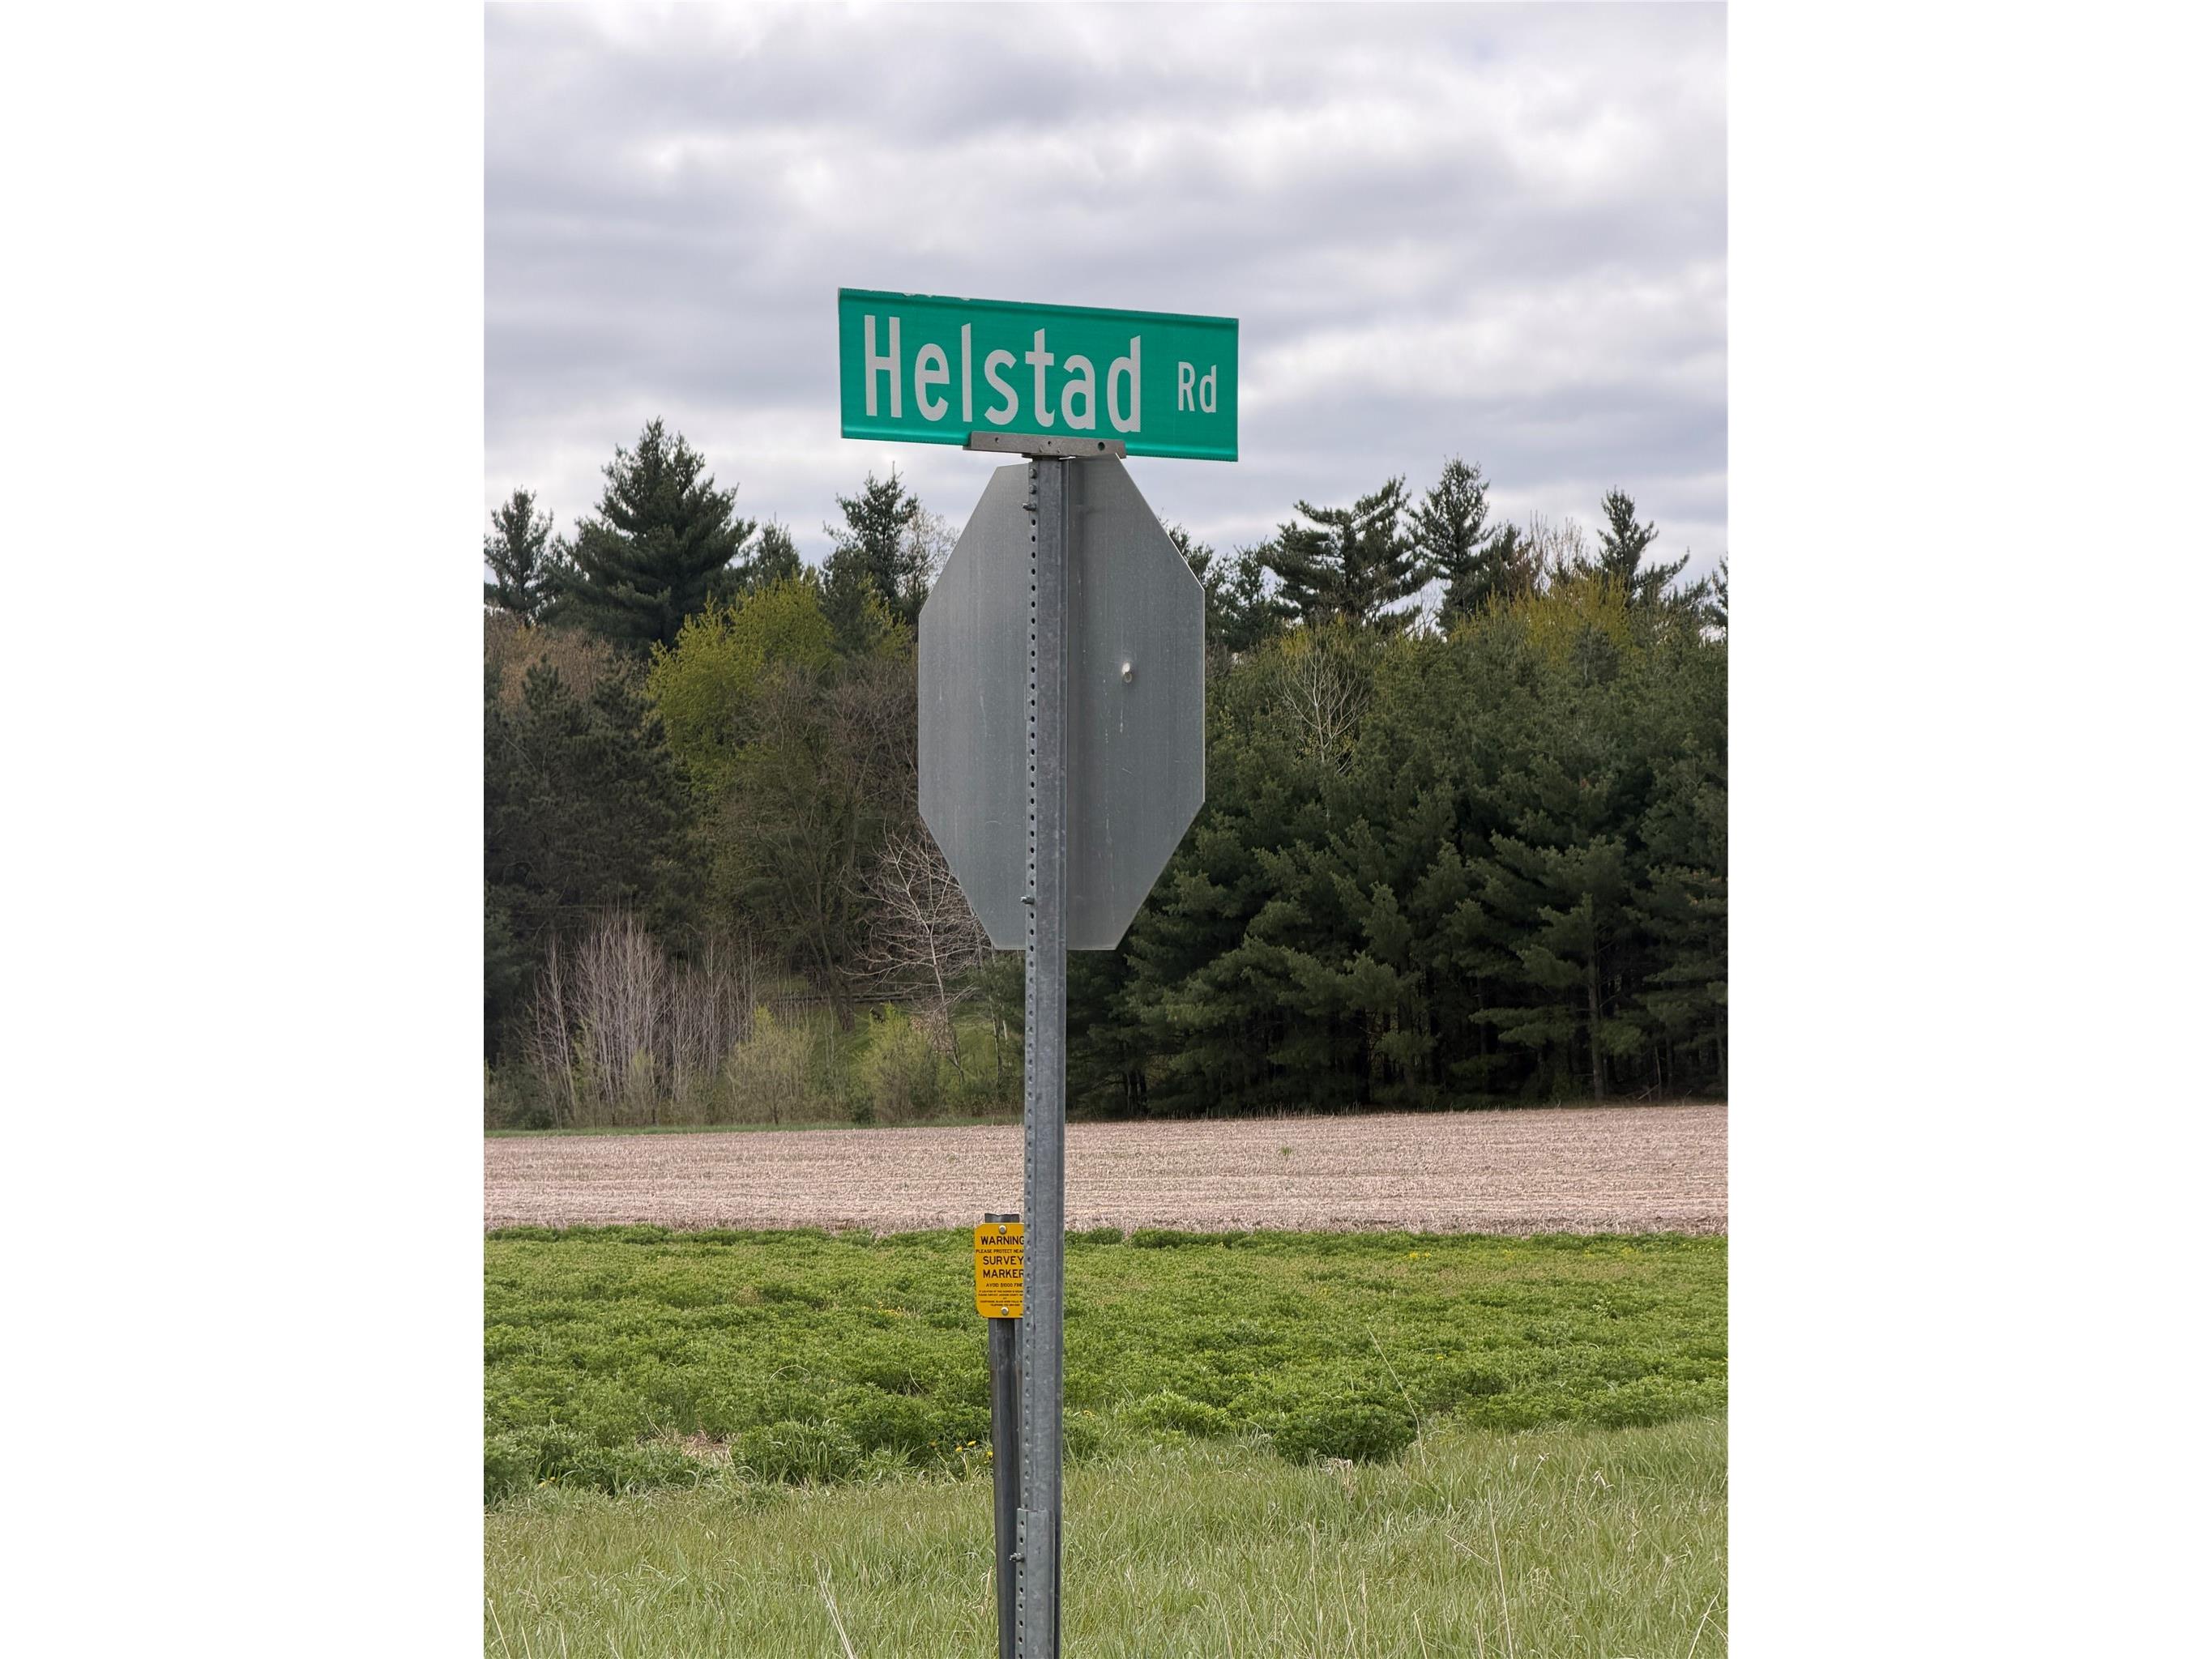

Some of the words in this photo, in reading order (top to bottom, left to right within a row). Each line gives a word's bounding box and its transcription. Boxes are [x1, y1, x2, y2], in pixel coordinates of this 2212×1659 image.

[864, 314, 1141, 433] Helstad
[1178, 361, 1217, 414] Rd
[980, 1236, 1024, 1245] WARNING
[983, 1256, 1024, 1265] SURVEY
[983, 1269, 1024, 1278] MARKER
